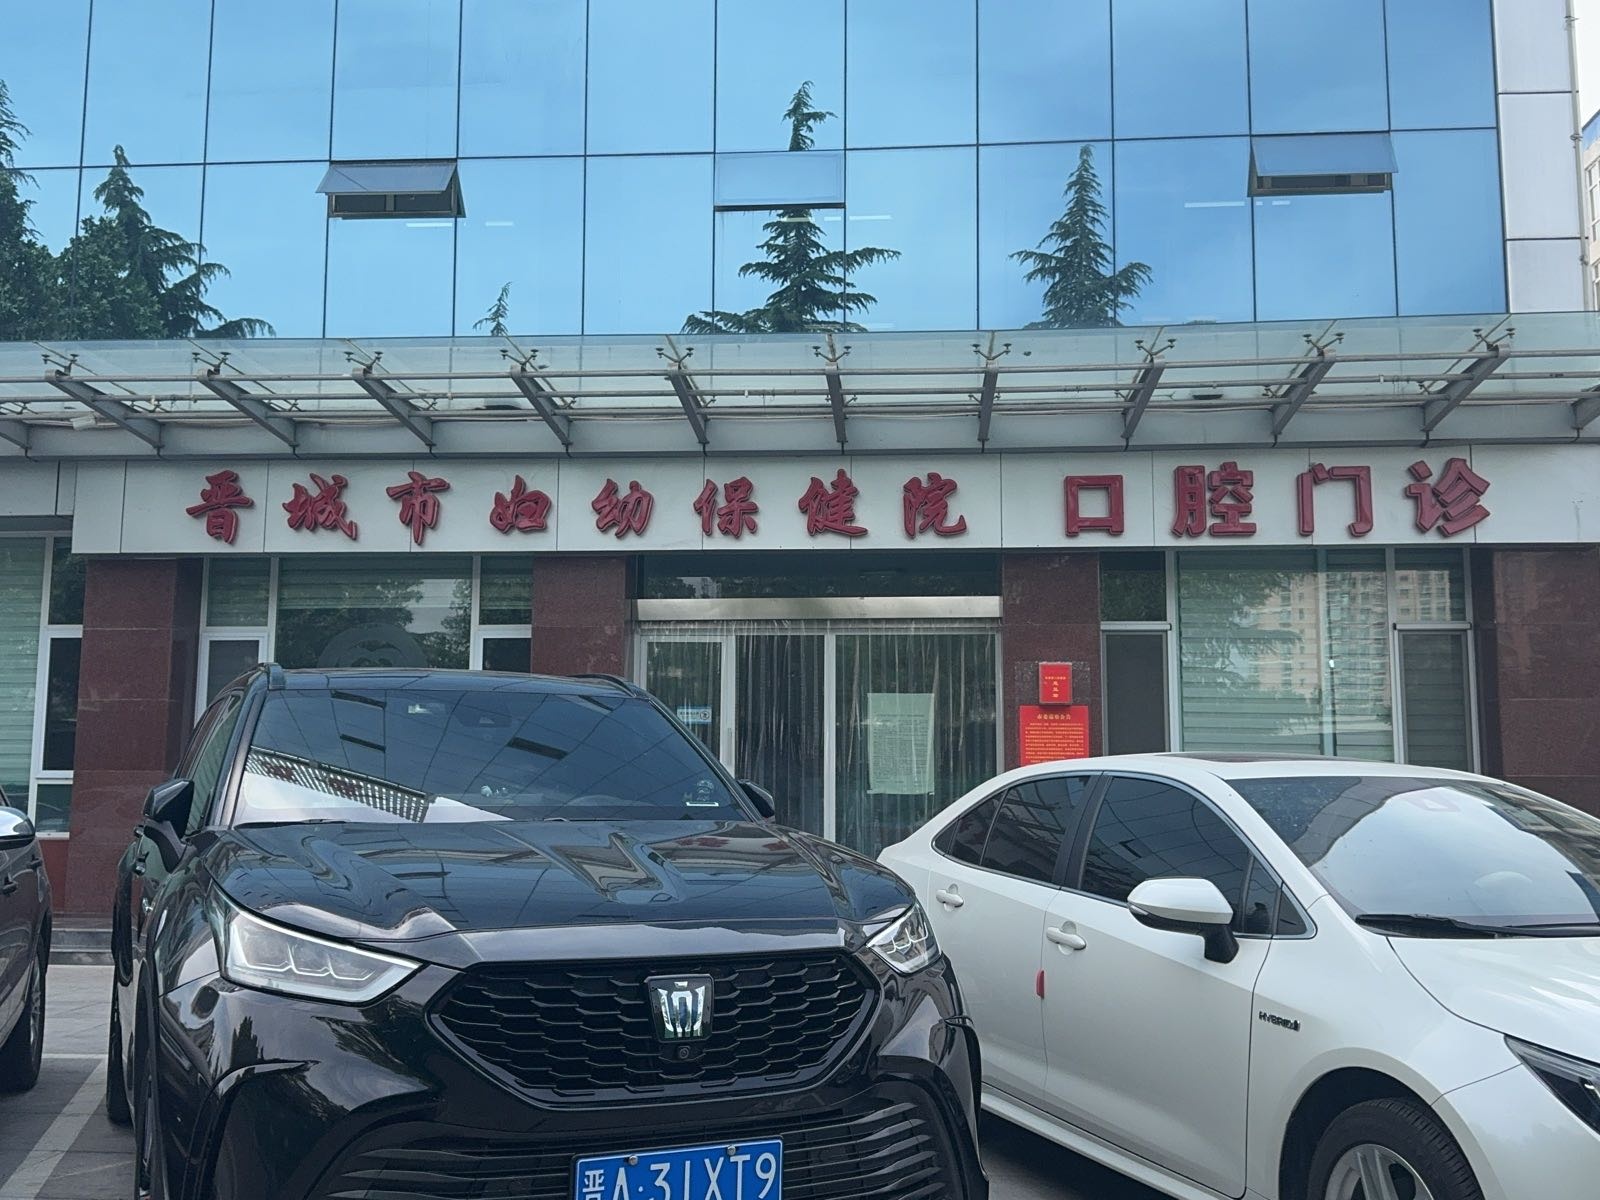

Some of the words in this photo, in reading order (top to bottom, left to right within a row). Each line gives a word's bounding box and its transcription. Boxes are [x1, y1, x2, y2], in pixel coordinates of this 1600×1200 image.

[186, 469, 967, 547] 晋城市妇幼保健院
[1063, 457, 1492, 538] 口腔门诊
